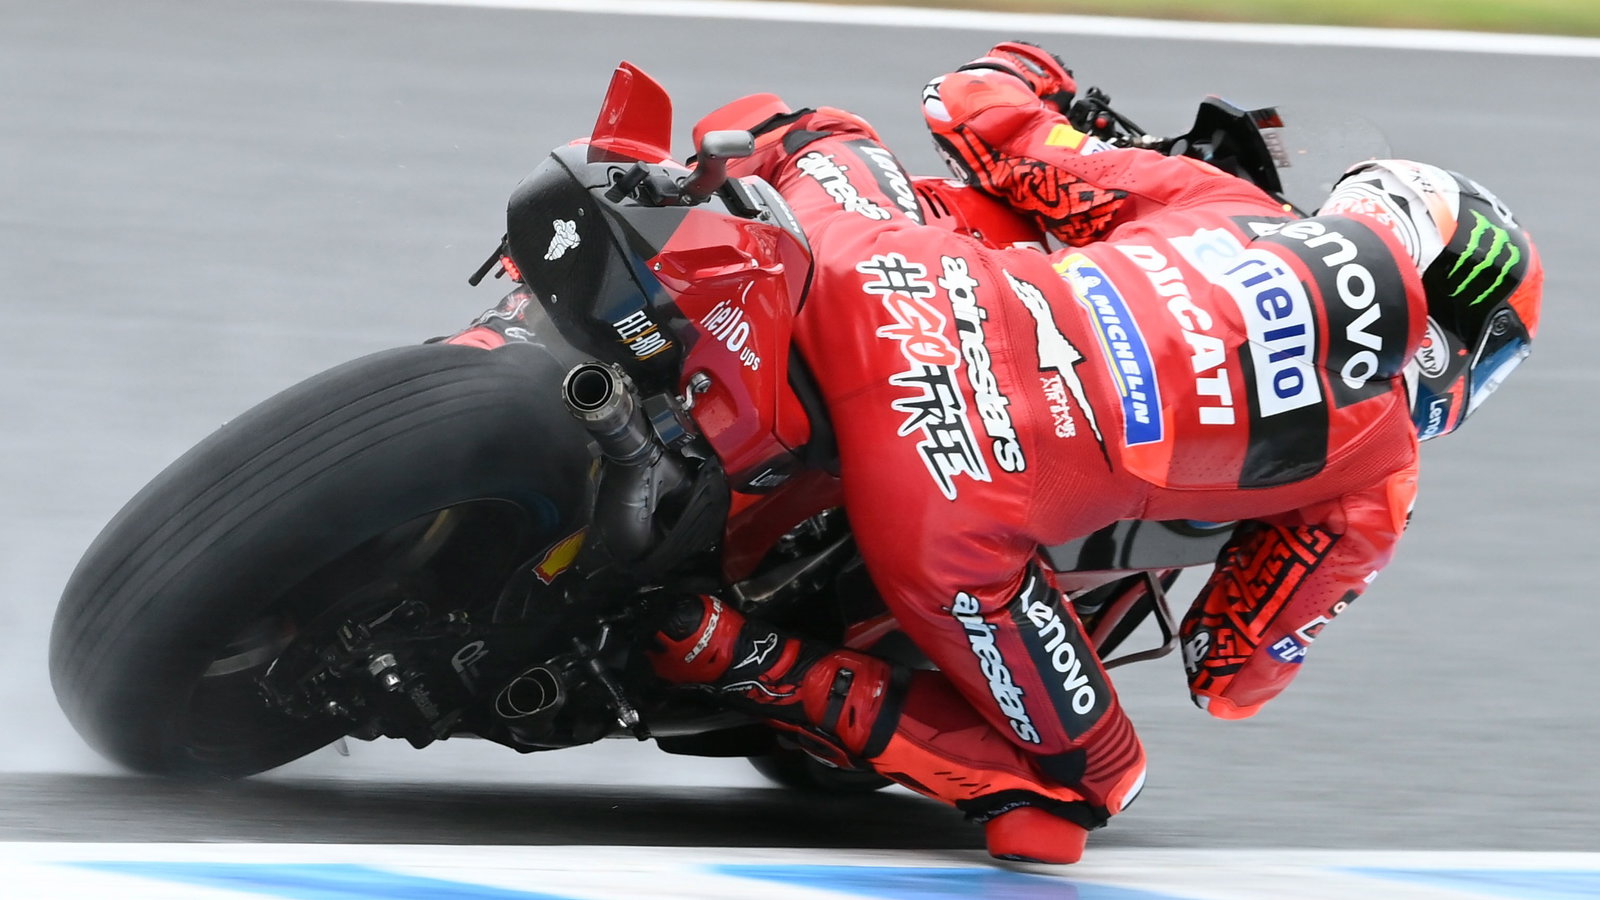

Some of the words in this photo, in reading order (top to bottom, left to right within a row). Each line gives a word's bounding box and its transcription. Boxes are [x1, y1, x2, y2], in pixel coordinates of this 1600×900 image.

[700, 300, 749, 352] riello
[739, 349, 760, 371] ups
[937, 255, 1027, 473] alpinestars
[1089, 294, 1150, 425] MICHELIN
[1115, 245, 1236, 425] DUCATI
[1223, 258, 1306, 400] riello
[1247, 221, 1383, 390] Lenovo
[942, 591, 1041, 744] ainestars
[1020, 576, 1096, 715] Lenovo
